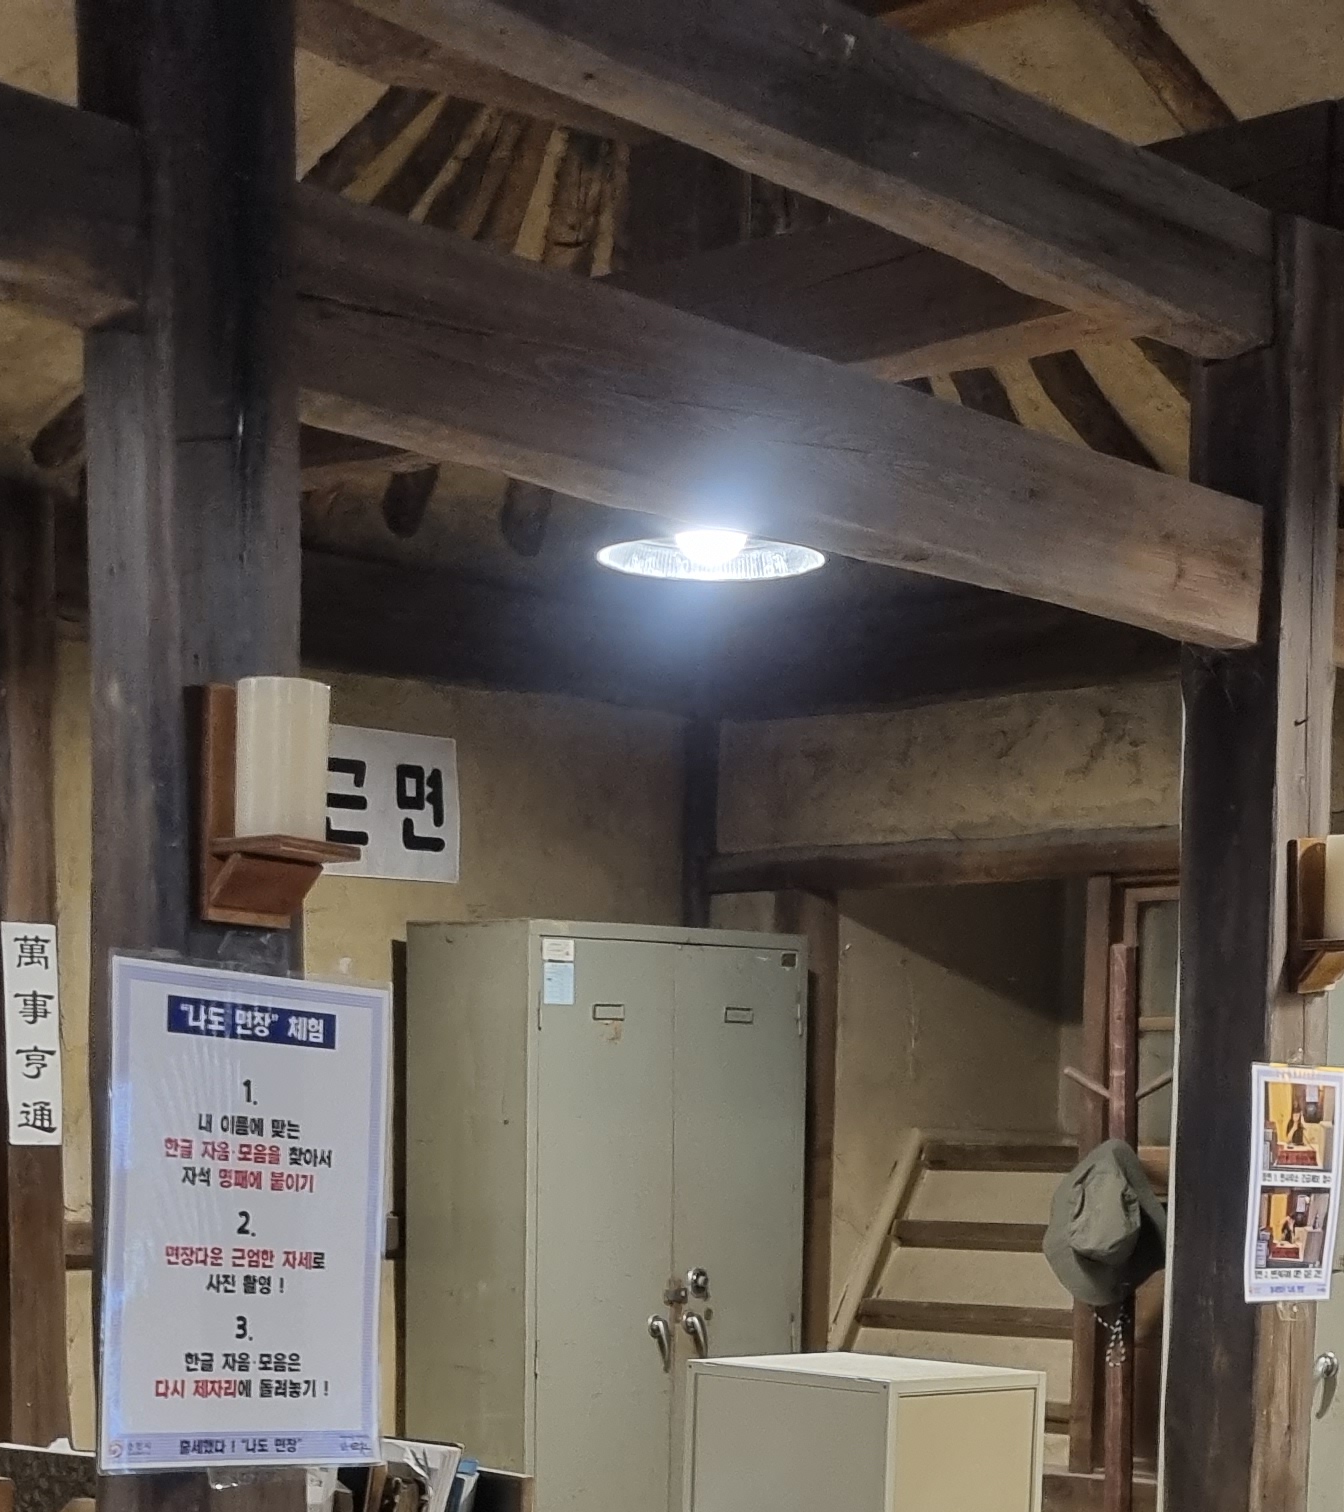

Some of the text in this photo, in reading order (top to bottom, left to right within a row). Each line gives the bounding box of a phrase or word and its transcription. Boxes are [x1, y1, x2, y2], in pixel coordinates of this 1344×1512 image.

[13, 935, 57, 1134] 萬事亨通
[288, 1016, 324, 1043] 체험
[242, 1079, 258, 1105] 1.
[198, 1113, 300, 1140] 내 이름에 맞는
[164, 1137, 193, 1159] 한글
[288, 1146, 333, 1168] 찾아서
[182, 1166, 314, 1193] 자석 명패에 붙이기
[237, 1210, 256, 1237] 2.
[165, 1245, 325, 1270] 면장다운 근엄한 자세로
[206, 1273, 236, 1293] 사진
[242, 1275, 272, 1295] 촬영
[235, 1315, 253, 1341] 3.
[184, 1351, 214, 1372] 한글
[155, 1379, 185, 1399] 다시
[193, 1379, 252, 1398] 제자리에
[259, 1379, 316, 1398] 돌려놓기
